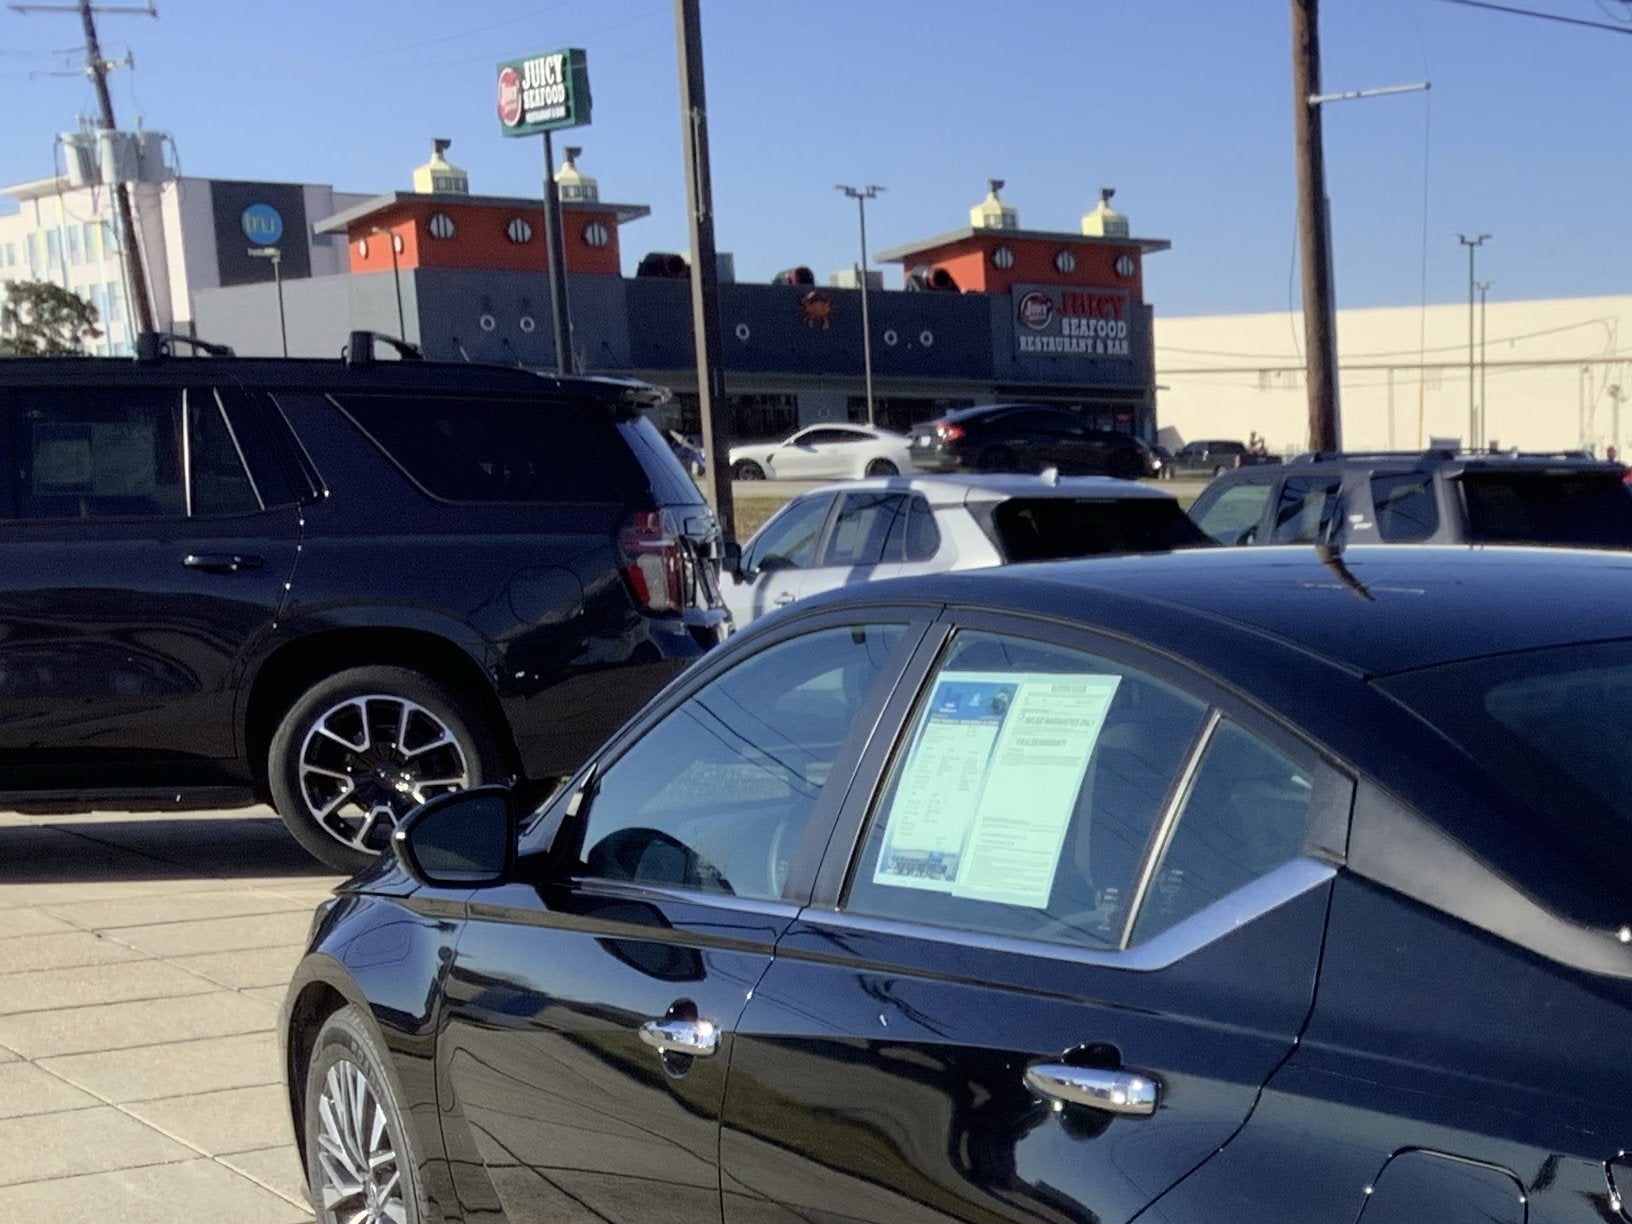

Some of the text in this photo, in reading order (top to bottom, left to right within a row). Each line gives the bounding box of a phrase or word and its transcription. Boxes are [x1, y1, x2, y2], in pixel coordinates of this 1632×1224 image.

[522, 54, 563, 90] JUICY
[523, 83, 566, 110] SEAFOOD
[1062, 318, 1127, 339] SEAFOOD
[1020, 335, 1093, 353] RESTAURANT
[1107, 340, 1129, 355] BAR
